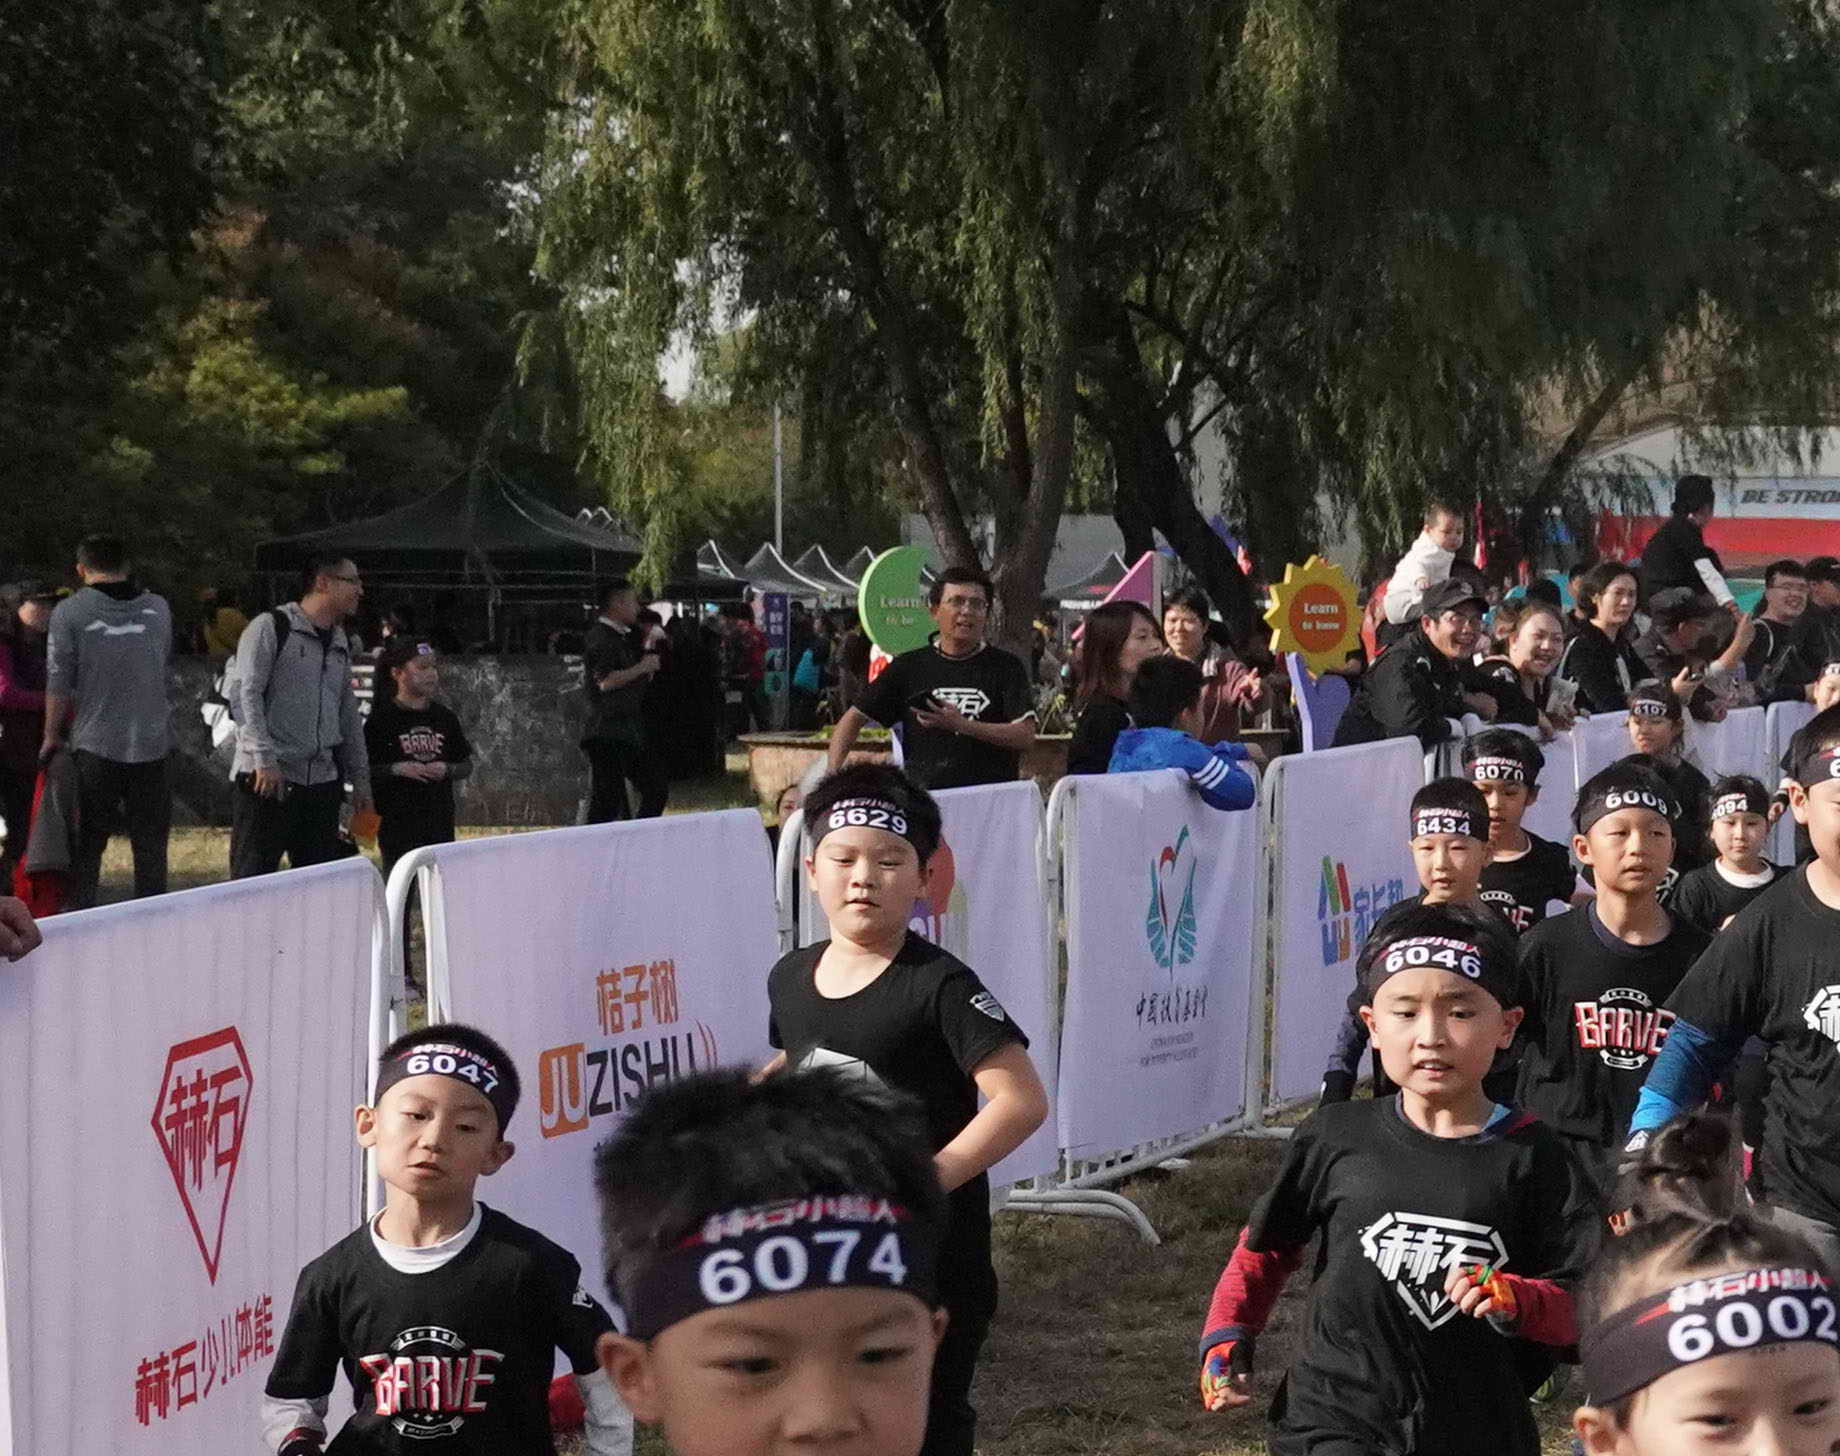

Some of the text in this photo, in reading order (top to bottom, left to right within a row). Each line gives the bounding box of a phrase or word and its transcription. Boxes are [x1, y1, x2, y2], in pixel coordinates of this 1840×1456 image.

[1303, 602, 1338, 615] Learn
[1474, 764, 1524, 782] 6070
[828, 807, 908, 836] 6629
[1606, 789, 1668, 816] 6009
[1418, 816, 1471, 837] 6434
[1385, 945, 1481, 980] 6046
[596, 959, 679, 1036] 桔子树
[1574, 1003, 1676, 1053] BARVE
[406, 1053, 499, 1094] 6047
[166, 1066, 241, 1192] 赫石
[701, 1230, 907, 1304] 6074
[1667, 1293, 1837, 1363] 6002
[135, 1295, 272, 1426] 赫石少儿体能
[360, 1350, 503, 1415] BARVE
